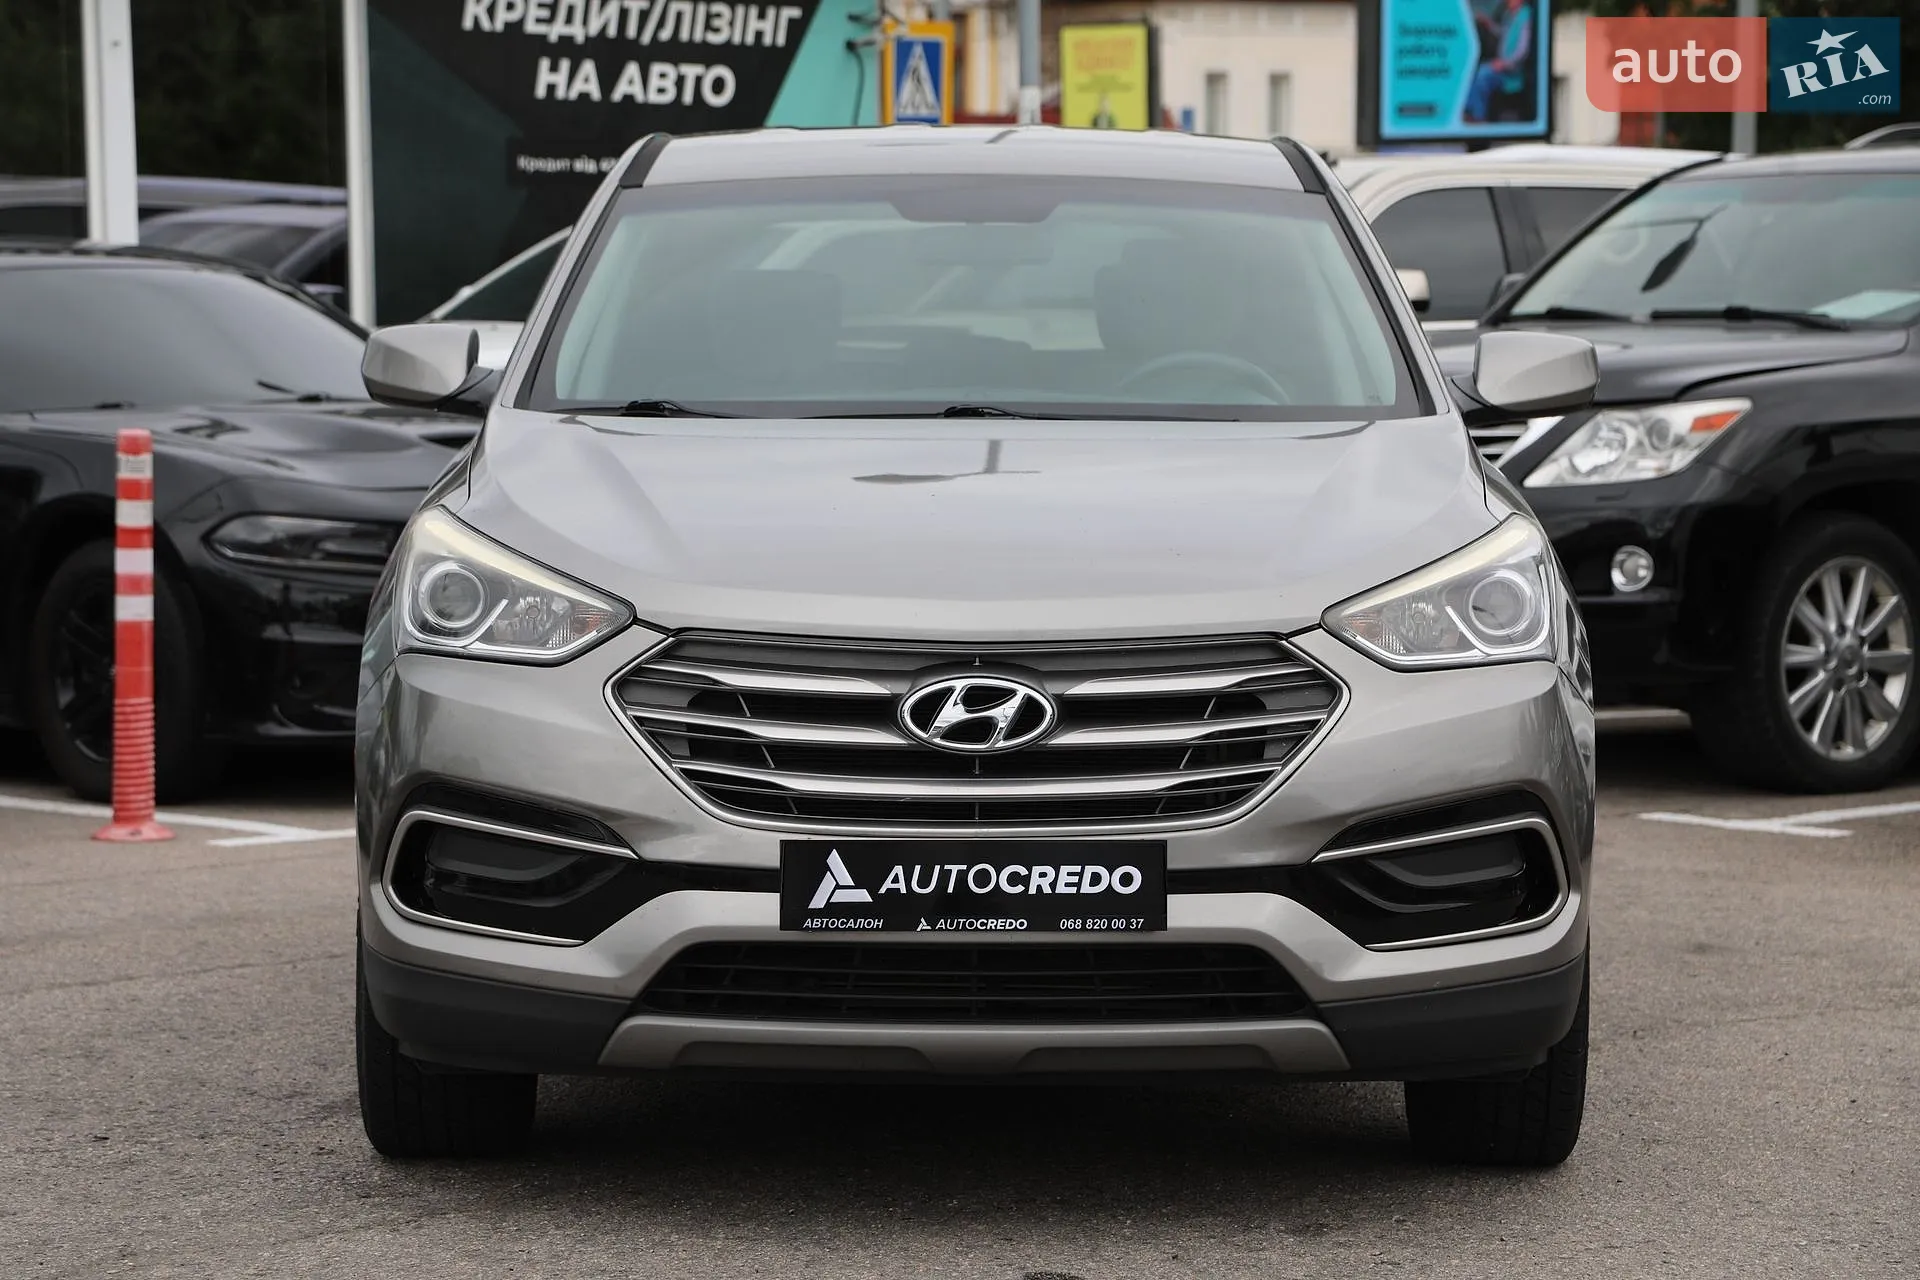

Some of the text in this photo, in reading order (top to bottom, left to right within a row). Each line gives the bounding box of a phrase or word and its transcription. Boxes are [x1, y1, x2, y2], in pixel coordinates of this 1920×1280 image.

[461, 0, 803, 47] КРЕДИТ/ЛІЗІНГ
[534, 56, 737, 107] НА АВТО
[516, 154, 571, 173] Кредит
[878, 863, 1142, 895] AUTOCREDO
[802, 918, 884, 929] АВТОСАЛОН
[935, 918, 1028, 930] AUTOCREDO
[1059, 918, 1145, 930] 068 820 00 37
